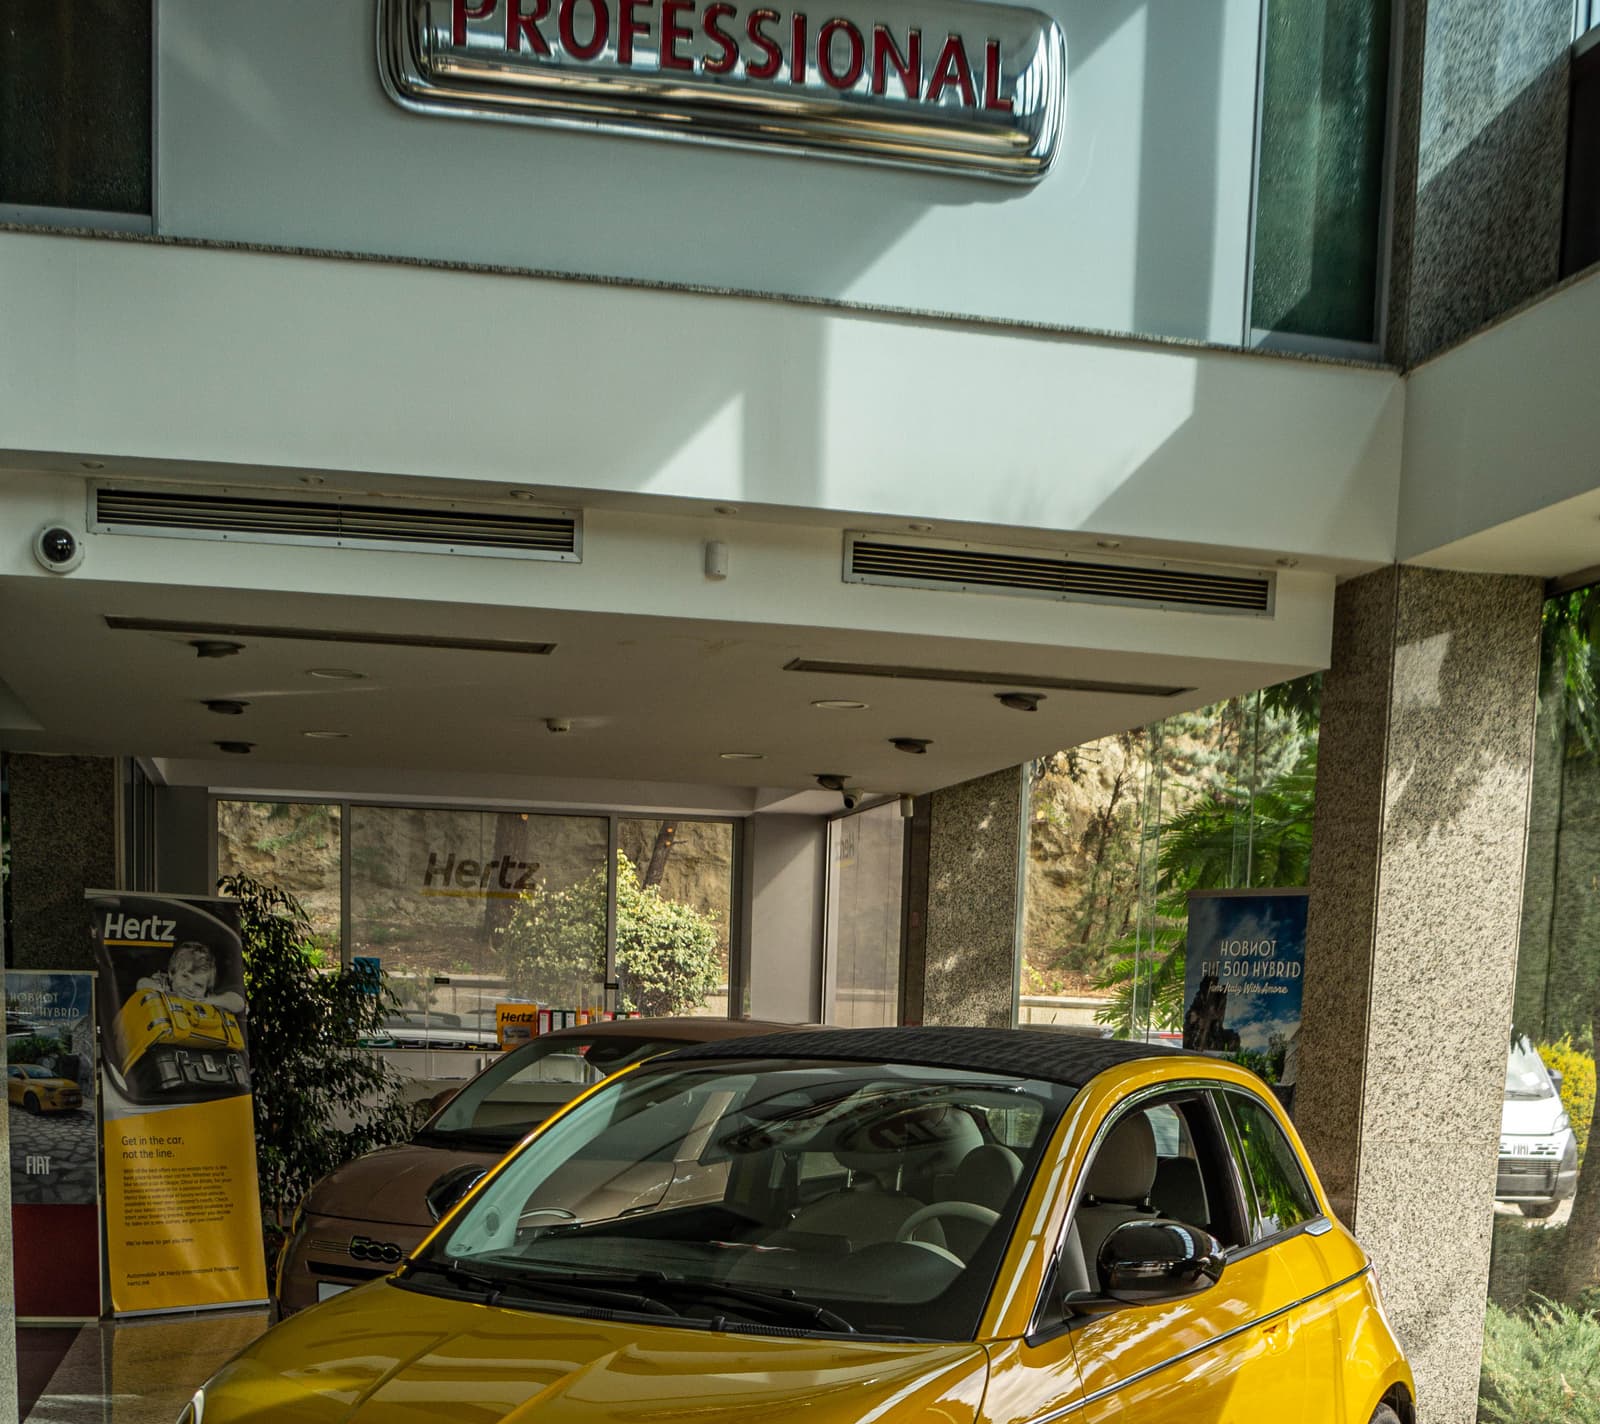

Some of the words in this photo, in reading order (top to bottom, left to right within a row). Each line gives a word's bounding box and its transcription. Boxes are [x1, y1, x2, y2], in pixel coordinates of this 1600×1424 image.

[452, 0, 1012, 111] PROFESSIONAL
[423, 852, 540, 889] Hertz
[104, 912, 177, 941] Hertz
[1220, 940, 1278, 957] НОВИОТ
[1223, 961, 1249, 977] 500
[1252, 961, 1301, 978] HYBRID
[1261, 981, 1289, 994] Amore
[39, 1007, 80, 1017] HYBRID
[501, 1012, 534, 1023] Hertz
[121, 1135, 137, 1146] Get
[139, 1135, 147, 1145] in
[149, 1135, 165, 1145] the
[122, 1150, 138, 1159] not
[139, 1149, 153, 1158] the
[156, 1149, 176, 1158] line.
[26, 1155, 51, 1175] FIAT
[351, 1236, 401, 1263] 500
